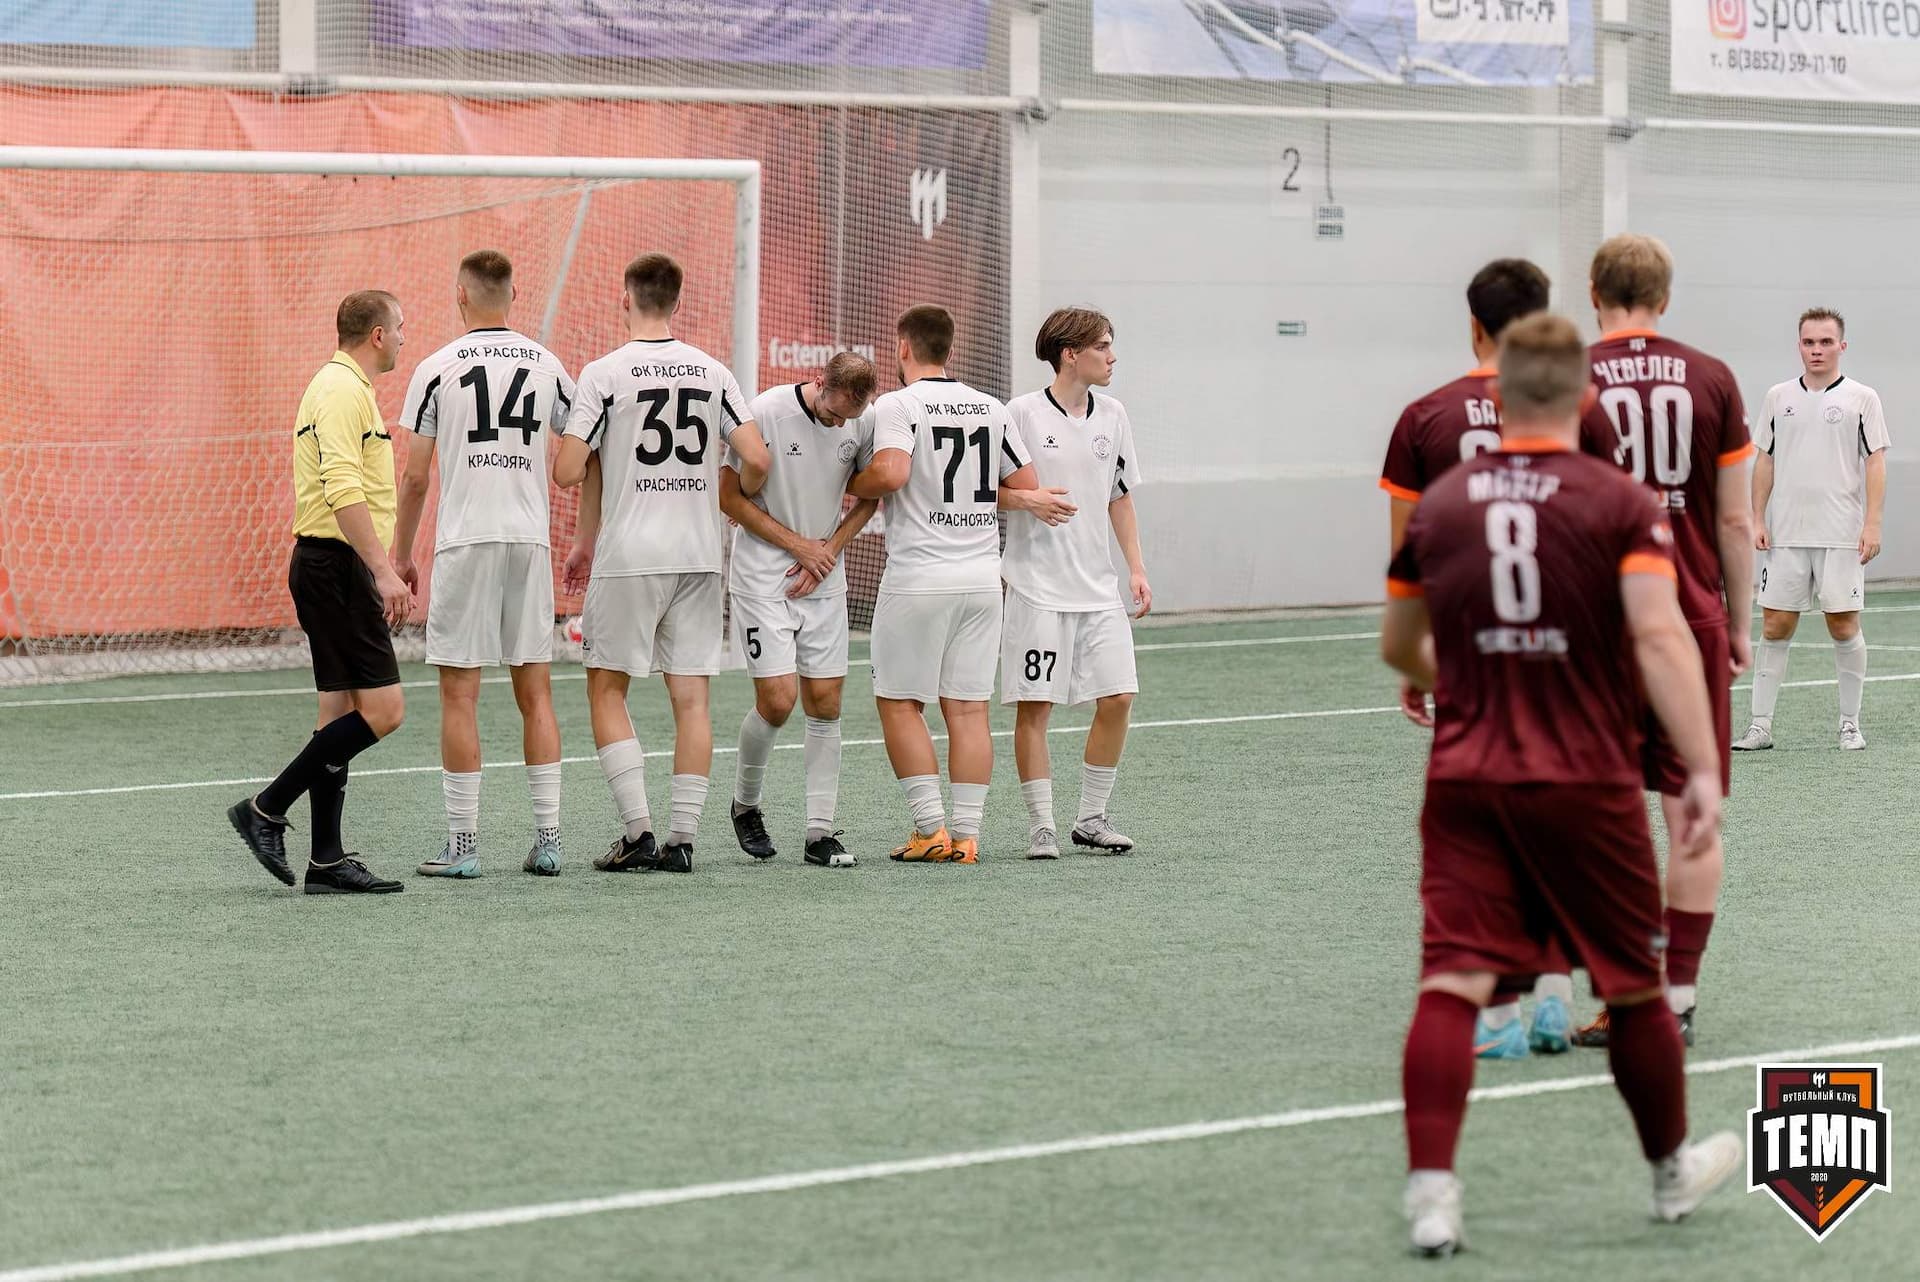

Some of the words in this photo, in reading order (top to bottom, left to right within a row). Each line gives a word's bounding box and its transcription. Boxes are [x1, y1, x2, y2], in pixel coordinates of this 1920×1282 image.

[1727, 48, 1785, 73] 8(3852)
[1282, 147, 1301, 191] 2
[457, 346, 480, 360] ФК
[483, 346, 542, 363] РАССВЕТ
[1592, 355, 1687, 385] ЧЕВЕЛЕВ
[631, 365, 652, 378] ФК
[653, 364, 707, 380] РАССВЕТ
[460, 365, 542, 446] 14
[943, 403, 992, 416] РАССВЕТ
[1464, 399, 1503, 427] БА
[635, 388, 713, 466] 35
[1600, 385, 1694, 486] 90
[931, 426, 997, 503] 71
[1485, 501, 1542, 624] 8
[746, 627, 762, 660] 5
[1024, 649, 1057, 682] 87
